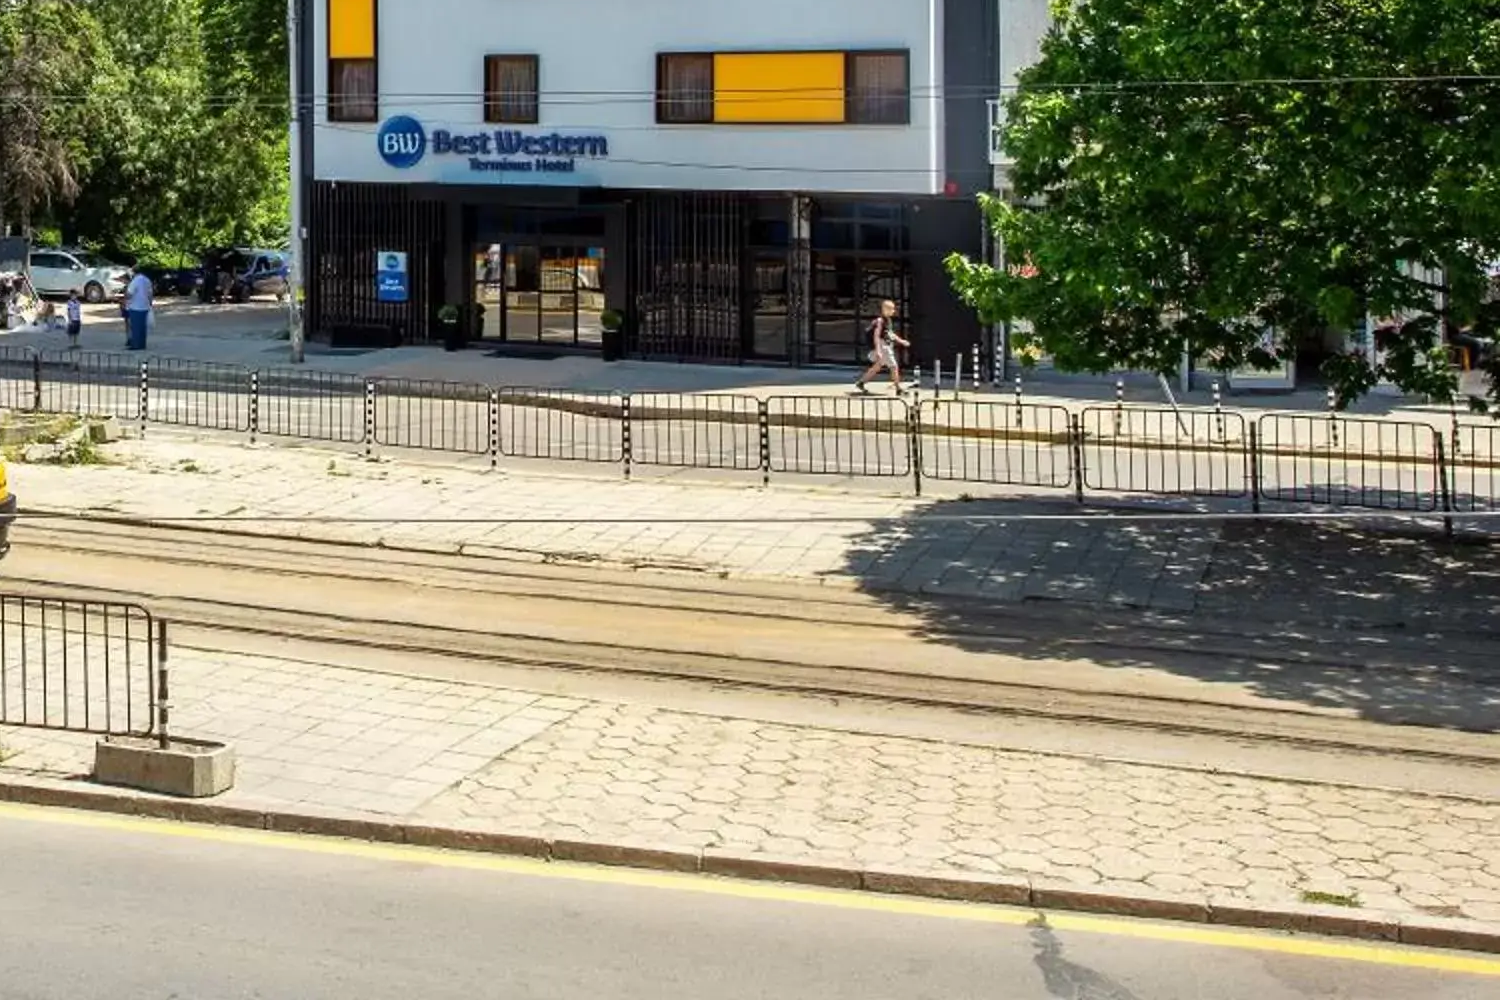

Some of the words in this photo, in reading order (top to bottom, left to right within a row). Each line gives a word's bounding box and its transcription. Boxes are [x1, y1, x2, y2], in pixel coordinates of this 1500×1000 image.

[431, 130, 491, 155] Best
[494, 130, 608, 156] Western
[468, 157, 533, 172] Terminus
[536, 157, 575, 173] Hotel
